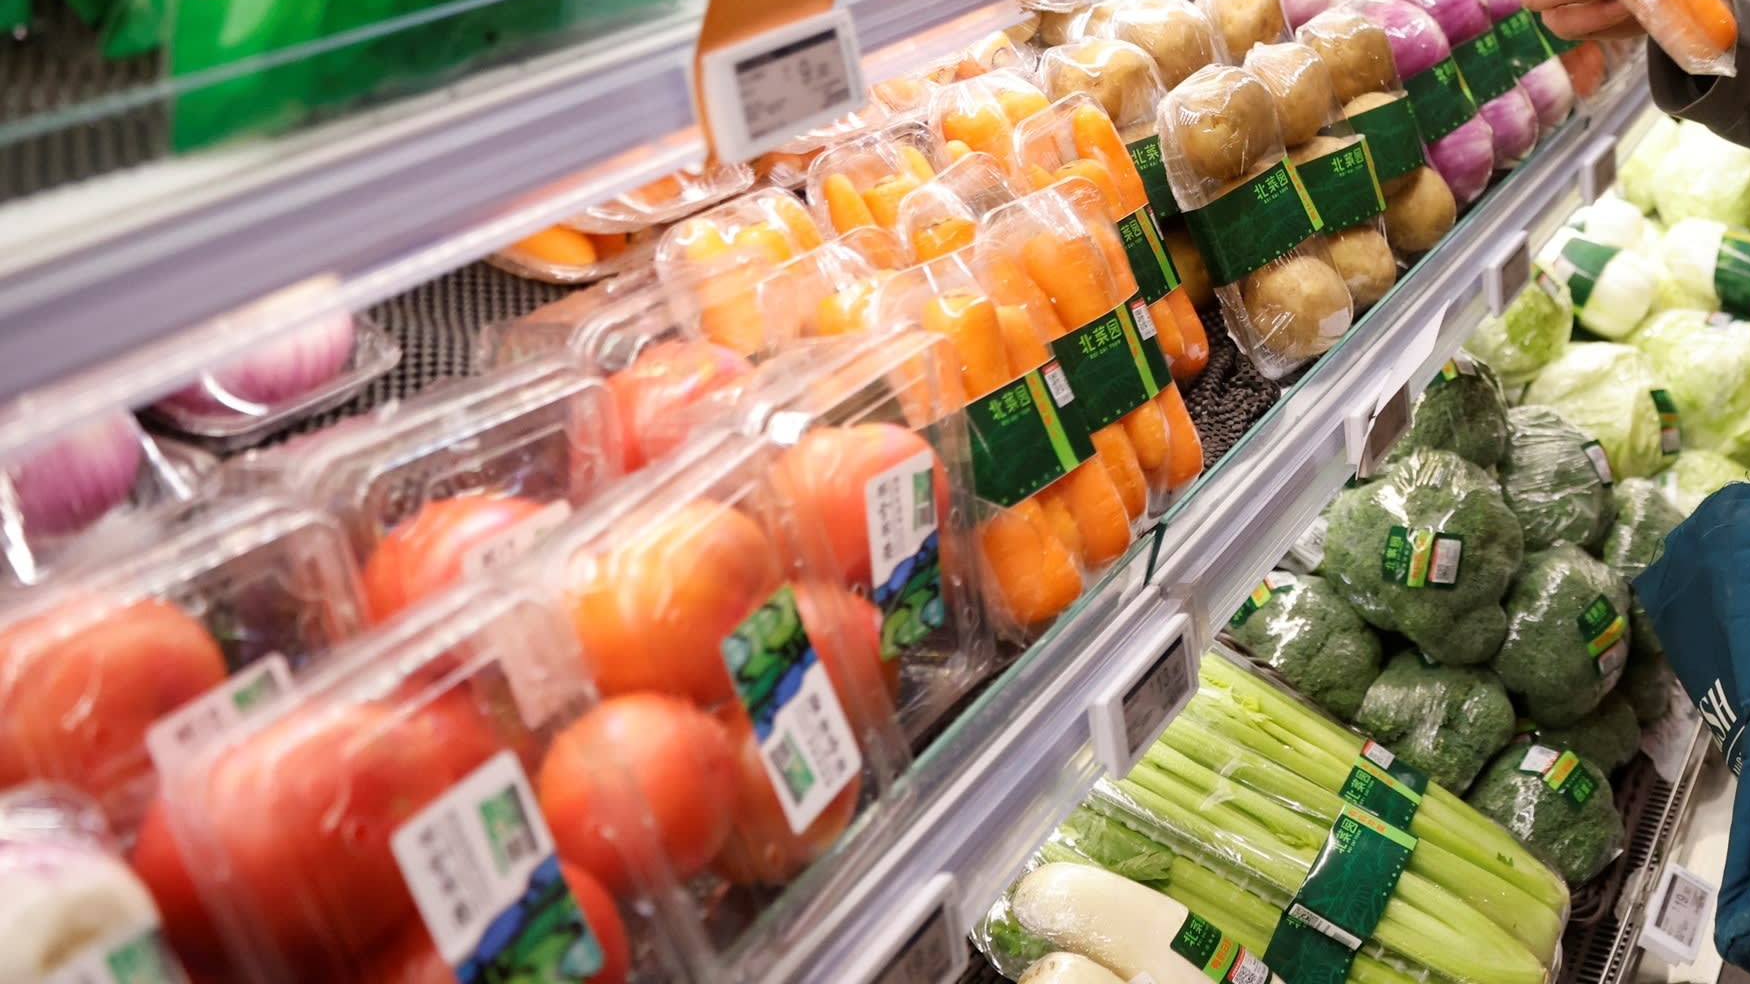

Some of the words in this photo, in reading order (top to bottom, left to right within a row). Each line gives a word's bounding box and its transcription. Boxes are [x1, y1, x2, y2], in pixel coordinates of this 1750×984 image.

[1131, 142, 1162, 166] 北菜
[1331, 147, 1365, 173] 北菜园
[1254, 168, 1289, 202] 北菜园
[1119, 218, 1143, 243] 菜园
[1078, 317, 1123, 355] 北菜园
[988, 383, 1031, 421] 北菜园
[1334, 817, 1359, 854] 北菜园
